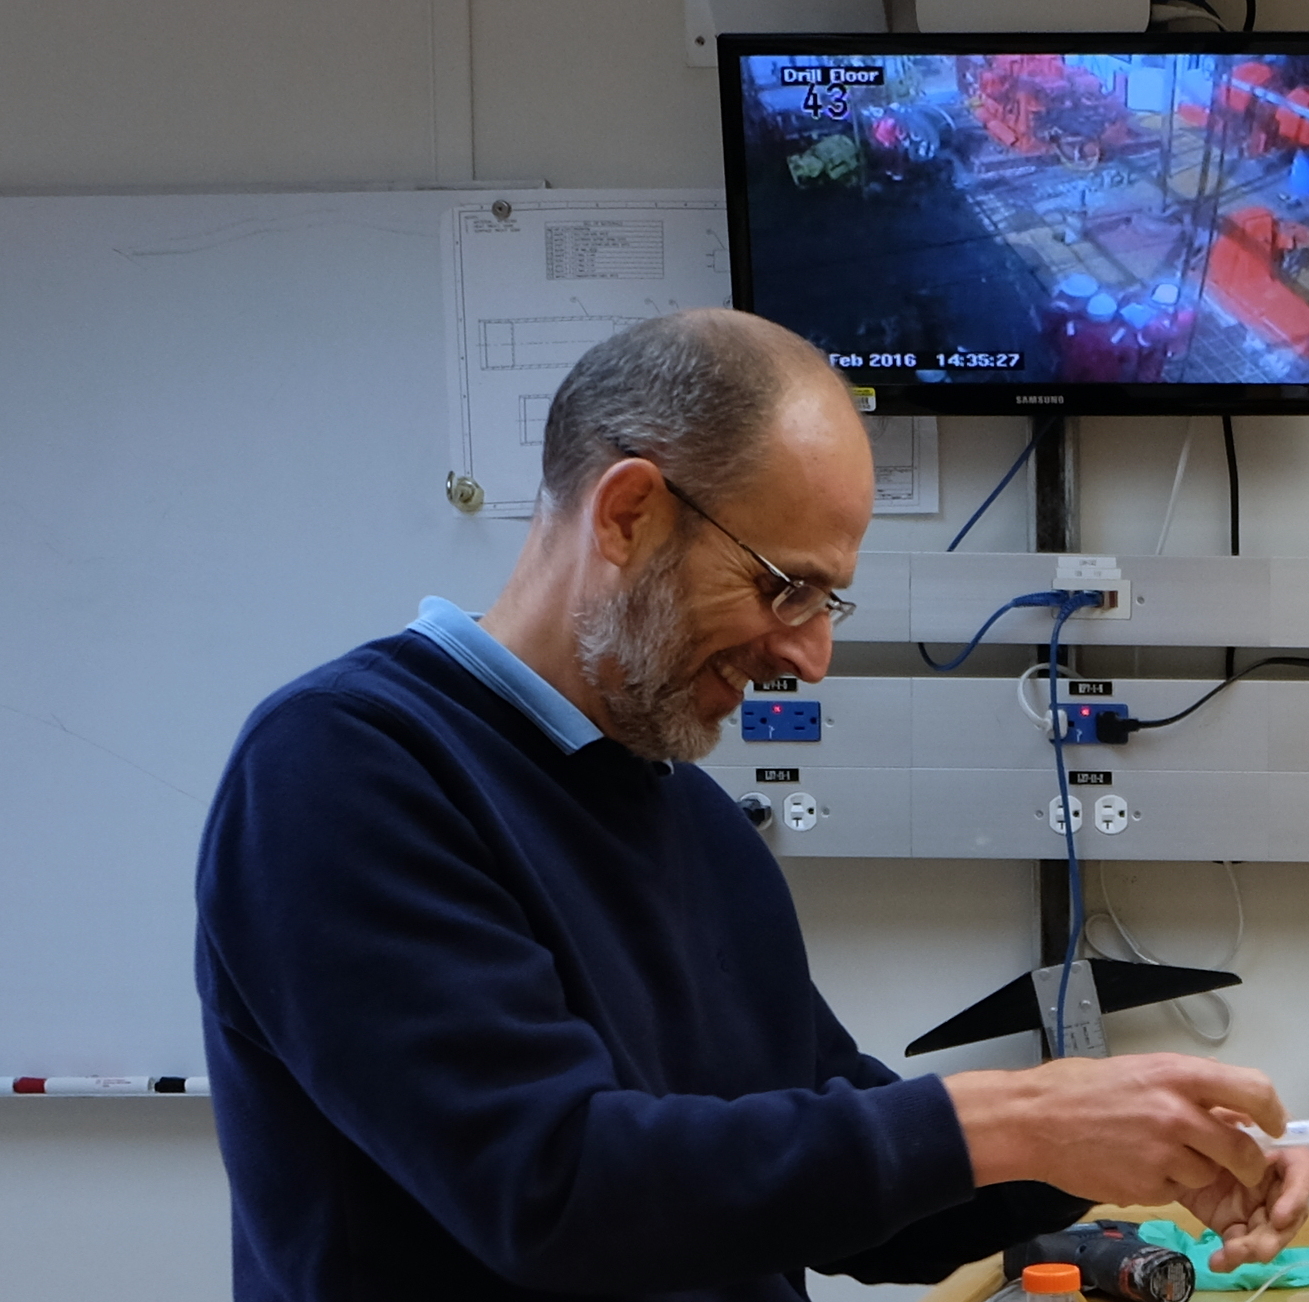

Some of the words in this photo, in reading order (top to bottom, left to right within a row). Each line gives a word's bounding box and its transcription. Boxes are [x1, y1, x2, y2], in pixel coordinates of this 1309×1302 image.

[783, 68, 821, 83] Drill
[829, 68, 879, 83] Floor
[802, 83, 849, 120] 43
[829, 353, 863, 367] Feb
[868, 353, 918, 367] 2016
[936, 353, 1020, 368] 14:35:27
[1015, 395, 1065, 405] SAMSUNG
